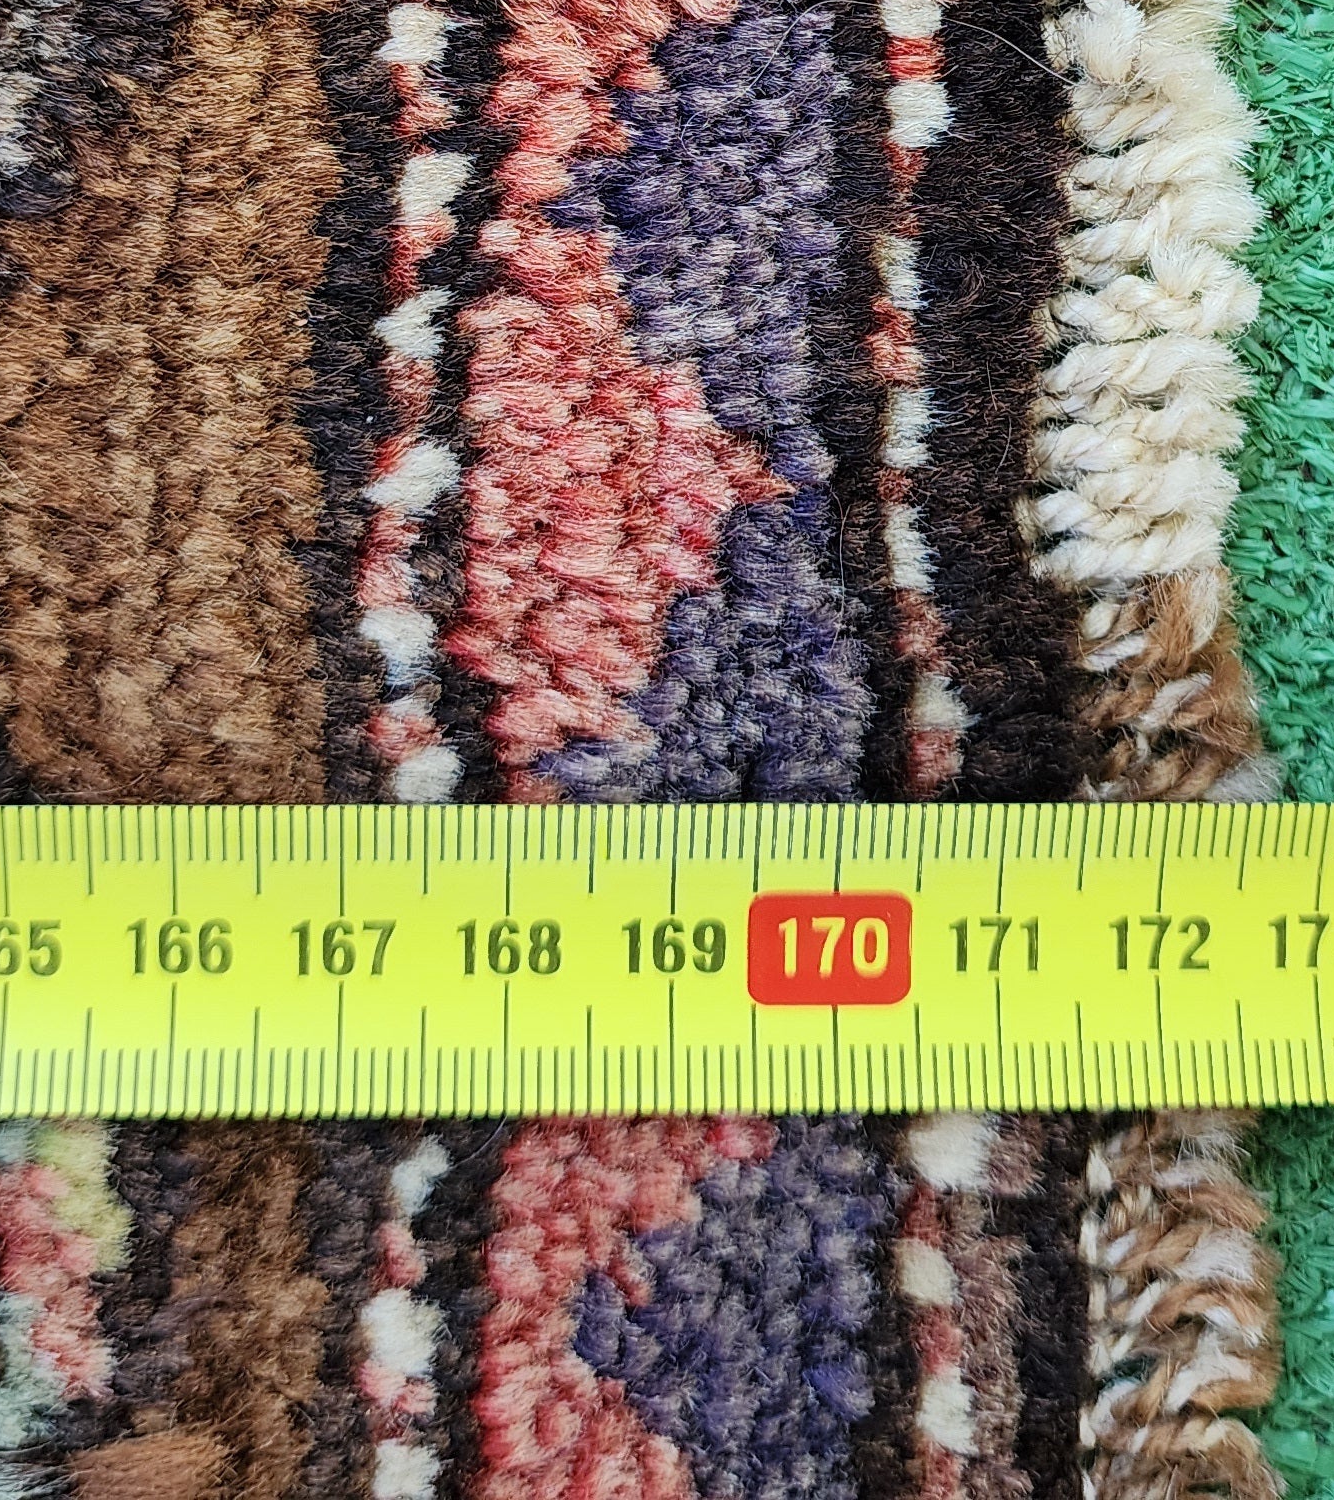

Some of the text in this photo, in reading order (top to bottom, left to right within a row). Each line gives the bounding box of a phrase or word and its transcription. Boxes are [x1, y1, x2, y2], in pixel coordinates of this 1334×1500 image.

[127, 919, 233, 975] 166
[291, 920, 397, 976] 167
[457, 919, 562, 975] 168
[622, 918, 727, 974] 169
[779, 917, 888, 976] 170
[950, 916, 1039, 972] 171
[1110, 915, 1211, 971] 172
